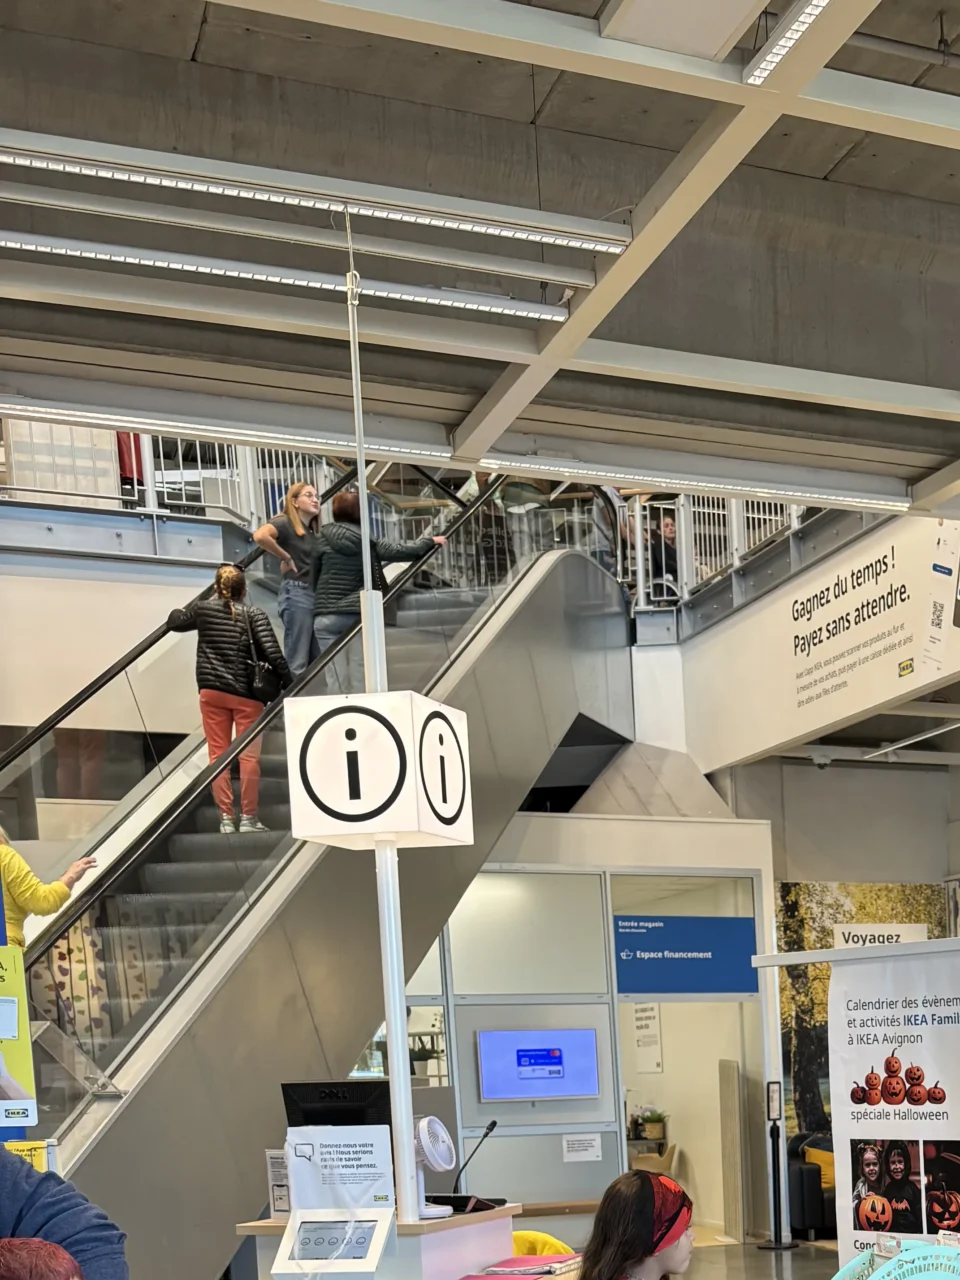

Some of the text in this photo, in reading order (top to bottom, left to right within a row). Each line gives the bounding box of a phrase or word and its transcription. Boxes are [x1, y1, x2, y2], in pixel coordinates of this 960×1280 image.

[791, 545, 895, 622] Gagnez du temps !
[793, 583, 910, 657] Payez sans attendre.
[869, 631, 886, 648] produits
[842, 932, 902, 946] Voyagez
[636, 950, 712, 960] Espace financement
[846, 998, 899, 1012] Calendrier
[902, 996, 918, 1009] des
[848, 1018, 857, 1028] et
[859, 1014, 900, 1028] activités
[903, 1014, 928, 1026] IKEA
[848, 1032, 923, 1048] à IKEA Avignon
[320, 1089, 349, 1100] DELL
[850, 1108, 949, 1123] spéciale Halloween
[356, 1162, 378, 1170] pensez.
